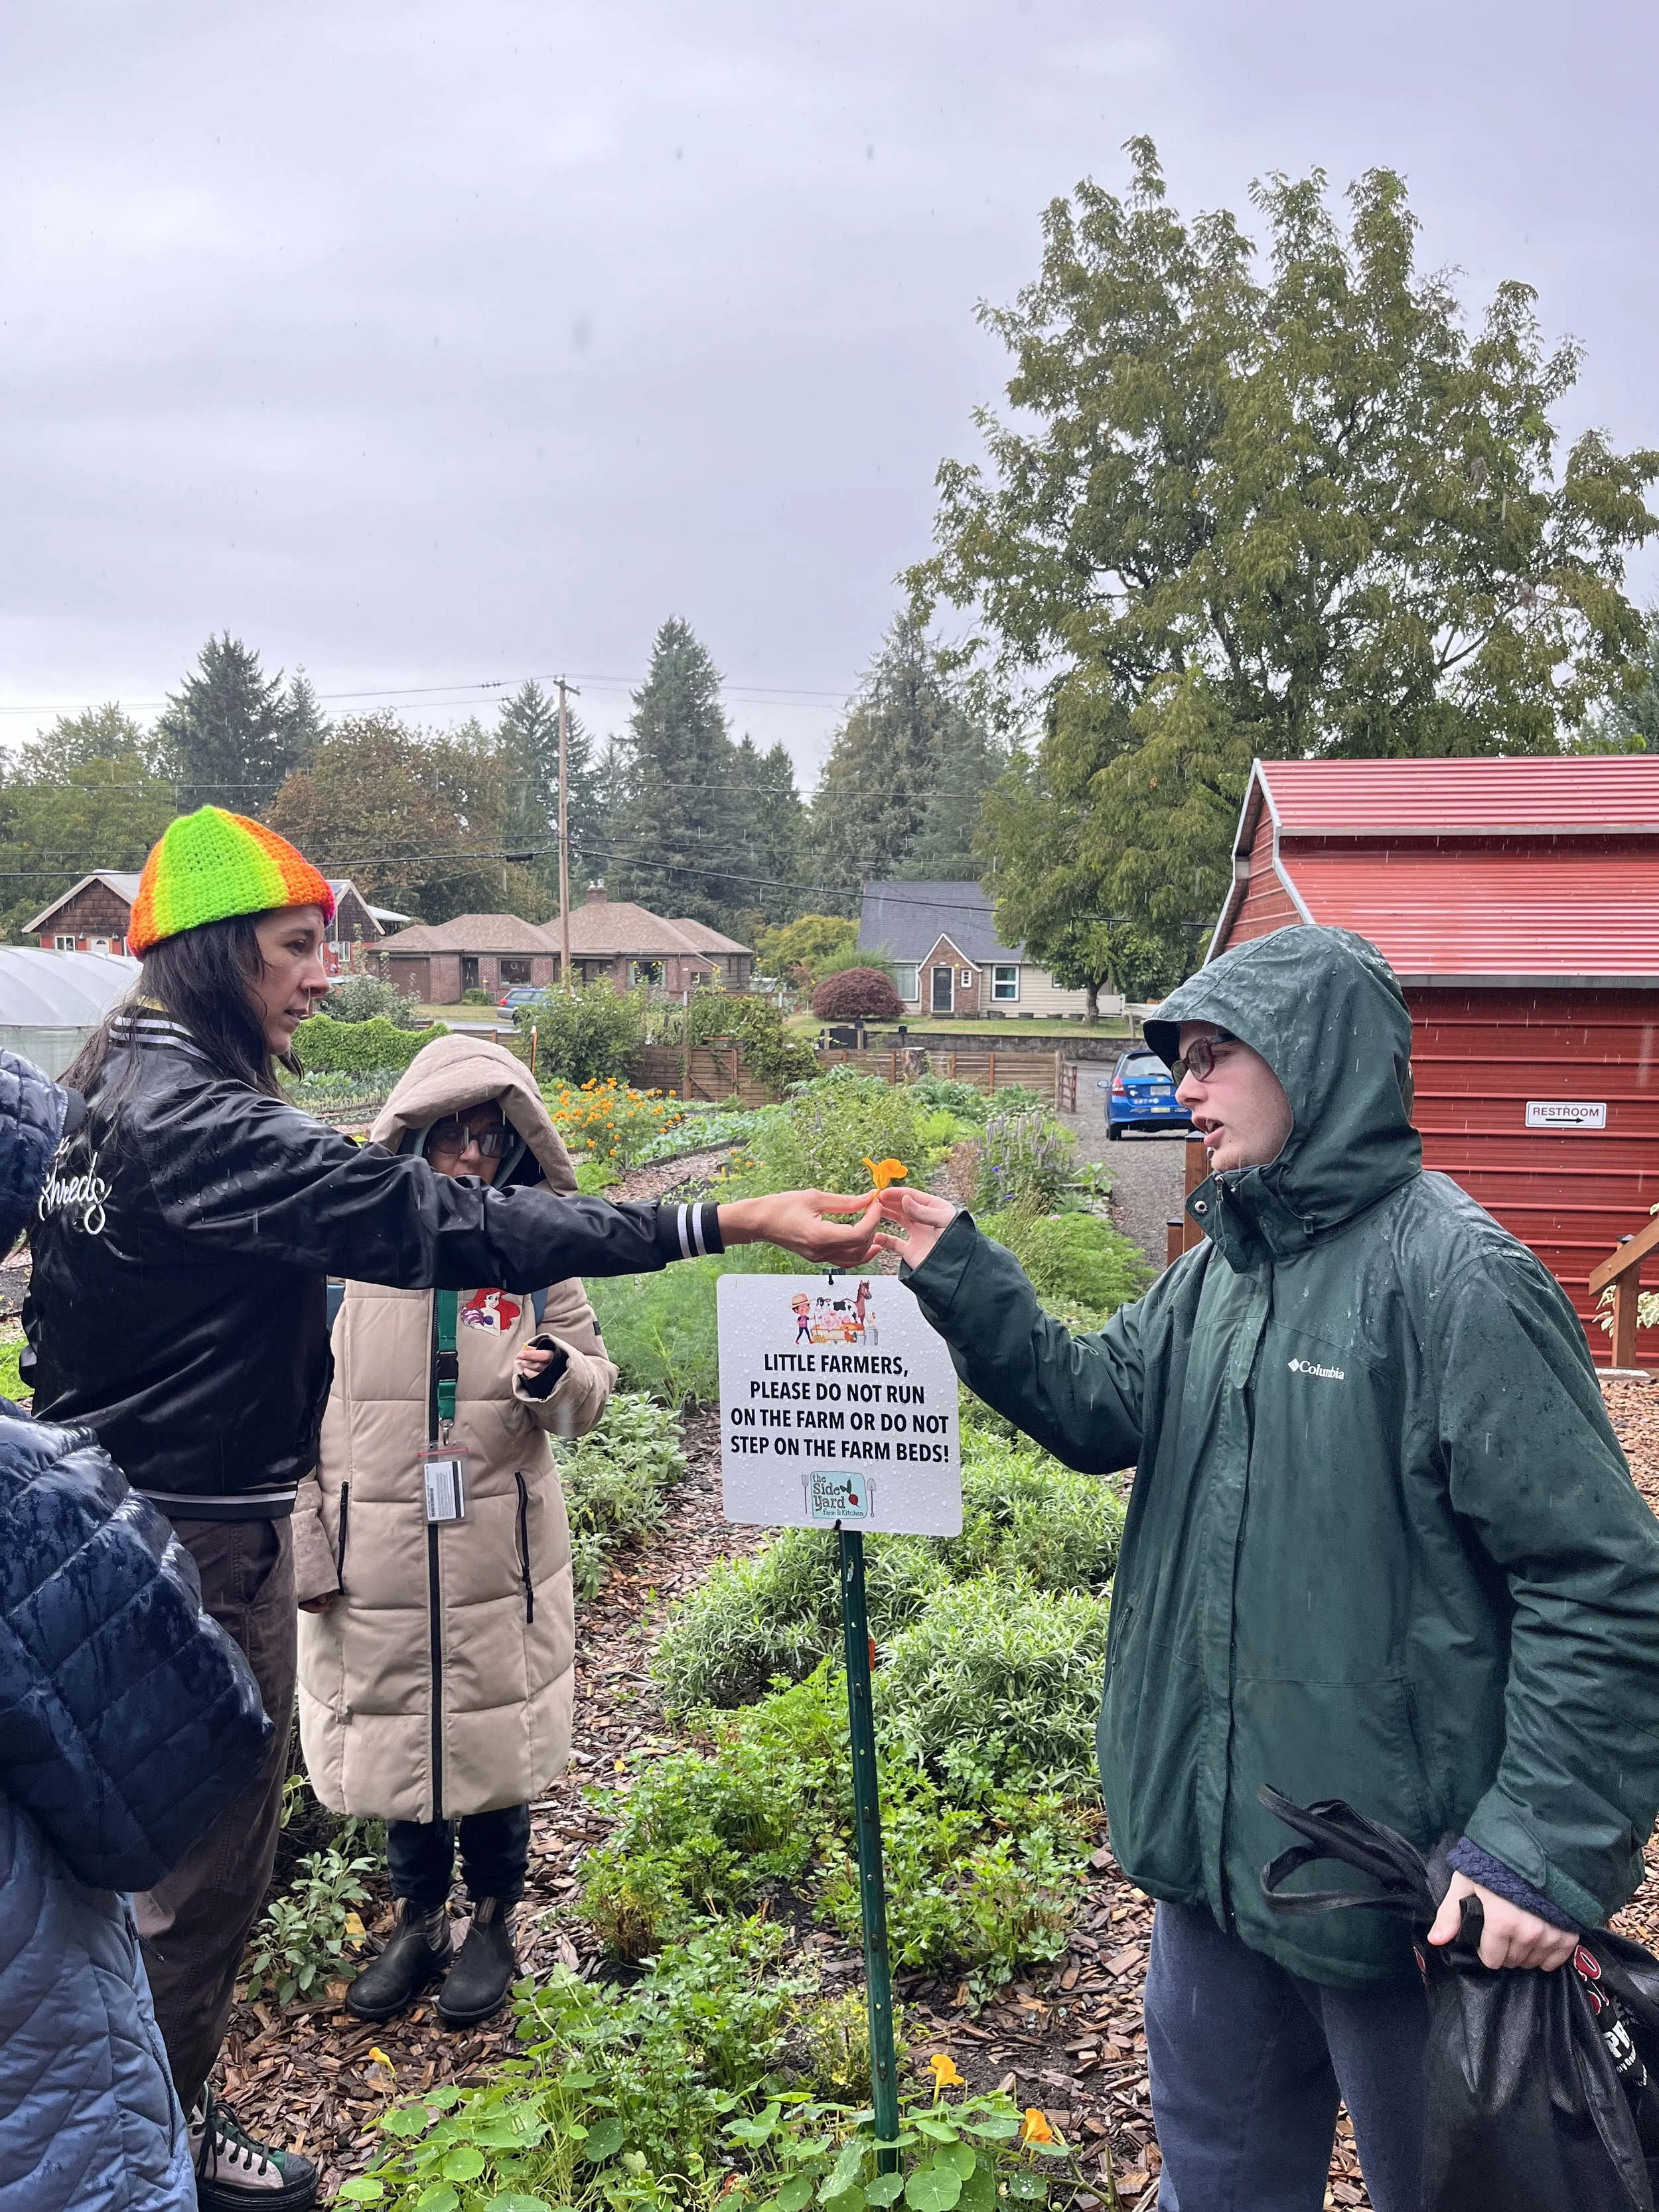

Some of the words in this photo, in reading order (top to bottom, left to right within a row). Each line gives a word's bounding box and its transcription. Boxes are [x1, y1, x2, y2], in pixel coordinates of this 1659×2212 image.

[1533, 1106, 1599, 1117] RESTROOM
[764, 1353, 816, 1372] LITTLE
[821, 1355, 908, 1378] FARMERS,
[1299, 1360, 1345, 1380] Columbia
[751, 1380, 811, 1400] PLEASE
[816, 1382, 841, 1401] DO
[847, 1384, 882, 1402] NOT
[887, 1385, 924, 1404] RUN
[731, 1408, 756, 1426] ON
[759, 1409, 792, 1428] THE
[796, 1410, 845, 1430] FARM
[850, 1412, 875, 1431] OR
[881, 1414, 907, 1432] DO
[912, 1414, 949, 1434] NOT
[731, 1435, 769, 1454] STEP
[774, 1437, 800, 1455] ON
[803, 1438, 836, 1457] THE
[841, 1440, 891, 1460] FARM
[896, 1443, 949, 1463] BEDS!
[812, 1473, 826, 1483] the
[813, 1482, 841, 1495] Side
